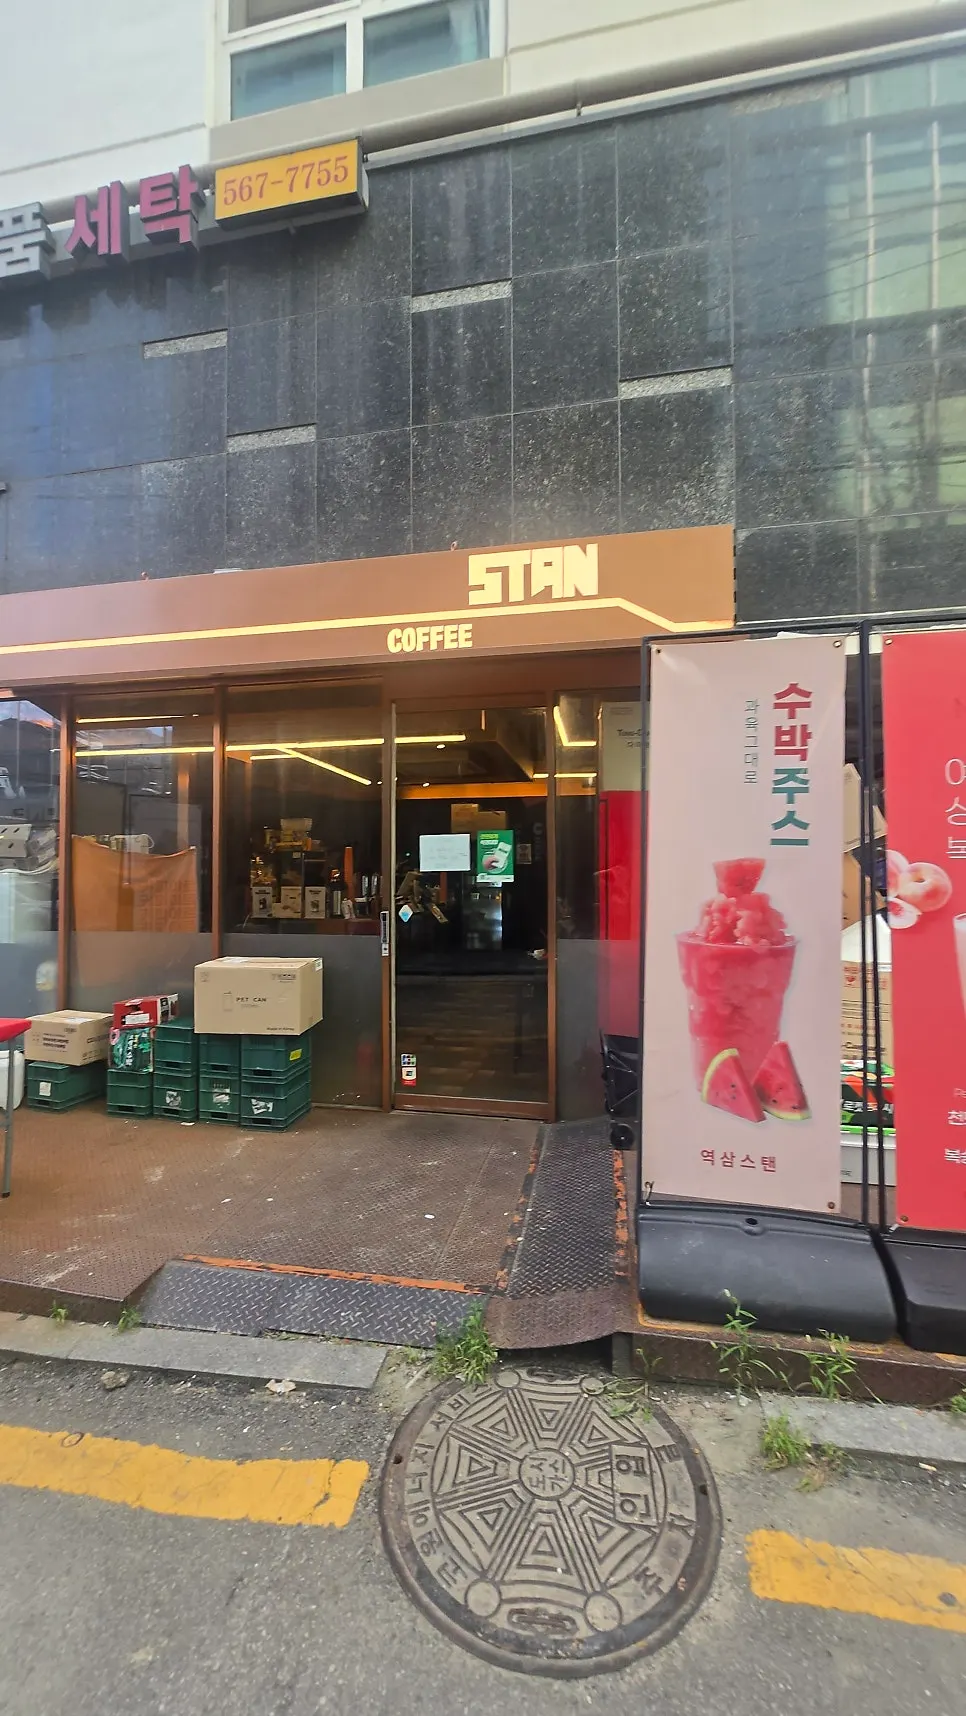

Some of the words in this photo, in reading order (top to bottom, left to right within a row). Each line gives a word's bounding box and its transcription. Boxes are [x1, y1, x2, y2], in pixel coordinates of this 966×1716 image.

[64, 165, 198, 255] 세탁
[223, 155, 349, 206] 567-7755
[468, 543, 599, 606] STAN
[386, 623, 473, 654] COFFEE
[769, 682, 814, 847] 수박주스
